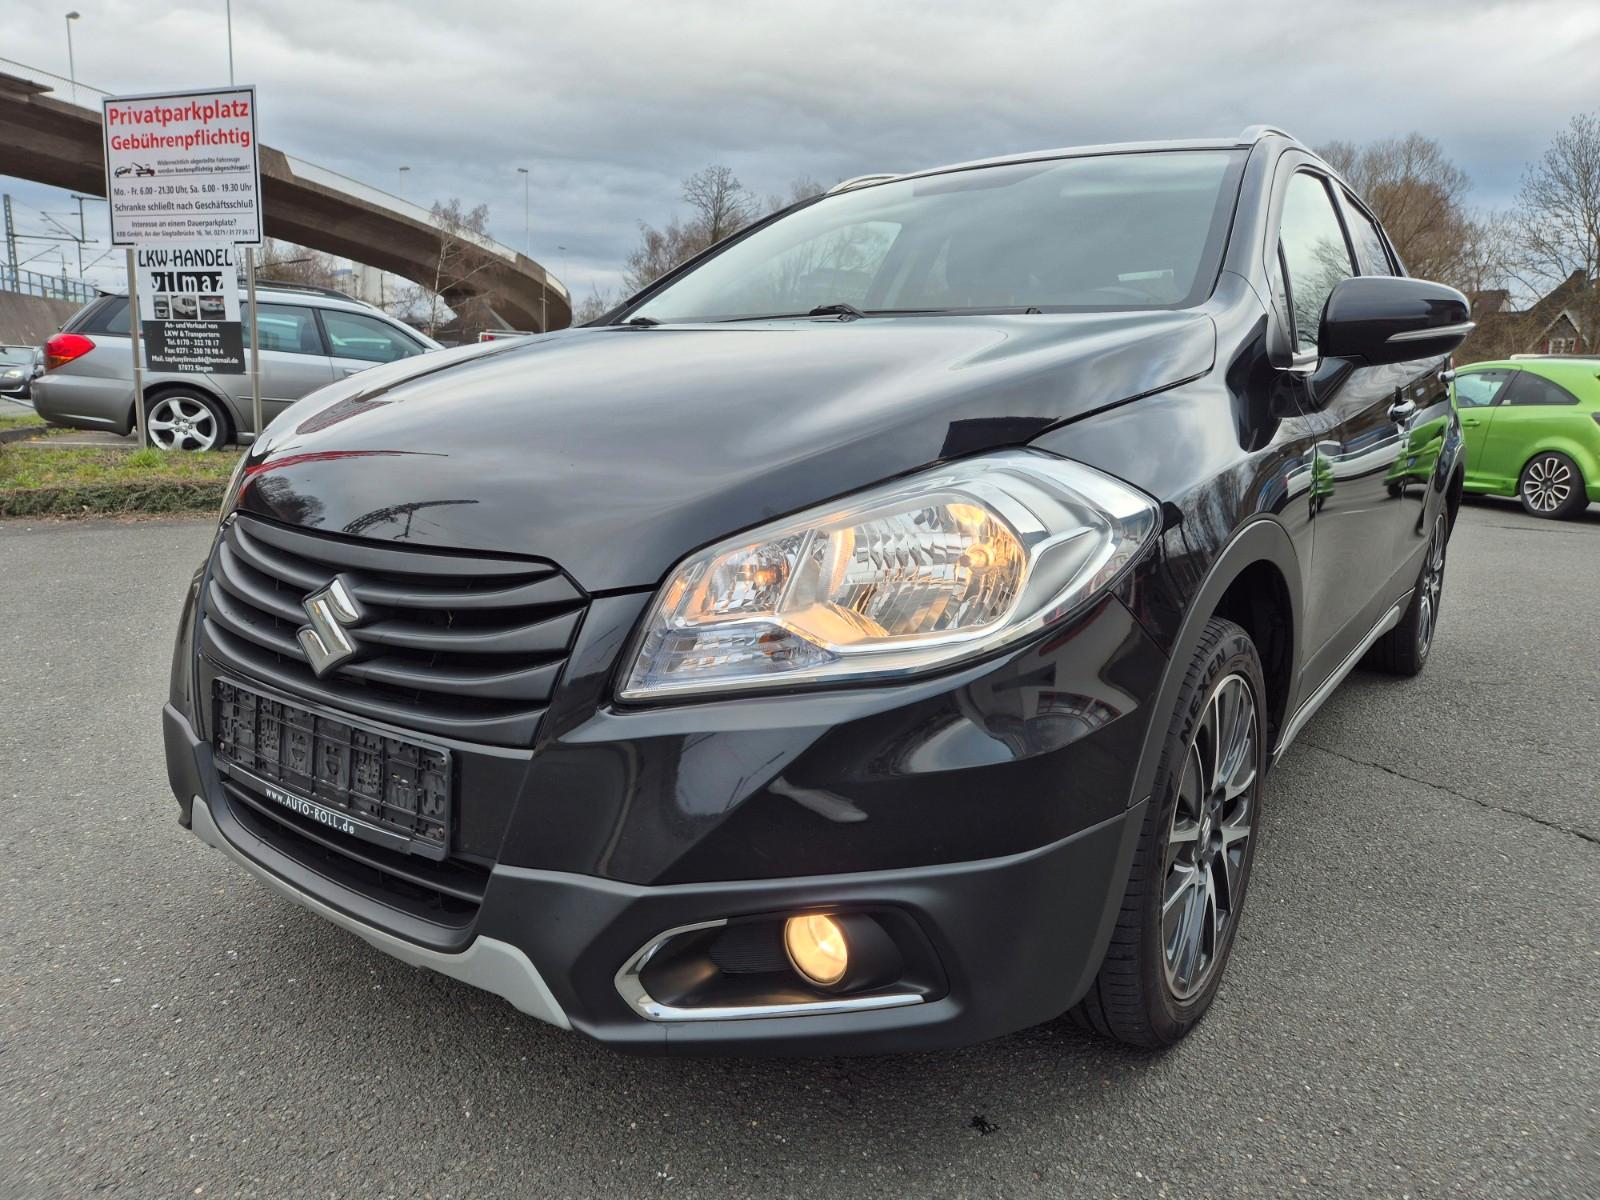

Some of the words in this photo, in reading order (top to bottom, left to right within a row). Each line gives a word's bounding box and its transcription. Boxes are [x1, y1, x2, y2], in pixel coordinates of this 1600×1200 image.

[109, 99, 248, 127] Privatparkplatz
[112, 128, 250, 150] Gebührenpflichtig
[158, 186, 174, 194] 21.30
[190, 185, 199, 193] Sa.
[115, 204, 146, 212] Schranke
[148, 202, 174, 210] schließt
[177, 201, 193, 209] nach
[195, 200, 253, 209] Geschäftsschluß
[188, 219, 236, 228] Dauerparkplatz?
[138, 249, 232, 267] LKW-HANDEL
[1180, 648, 1226, 745] NEXEN
[265, 787, 354, 834] www.AUTO-ROLL.de
